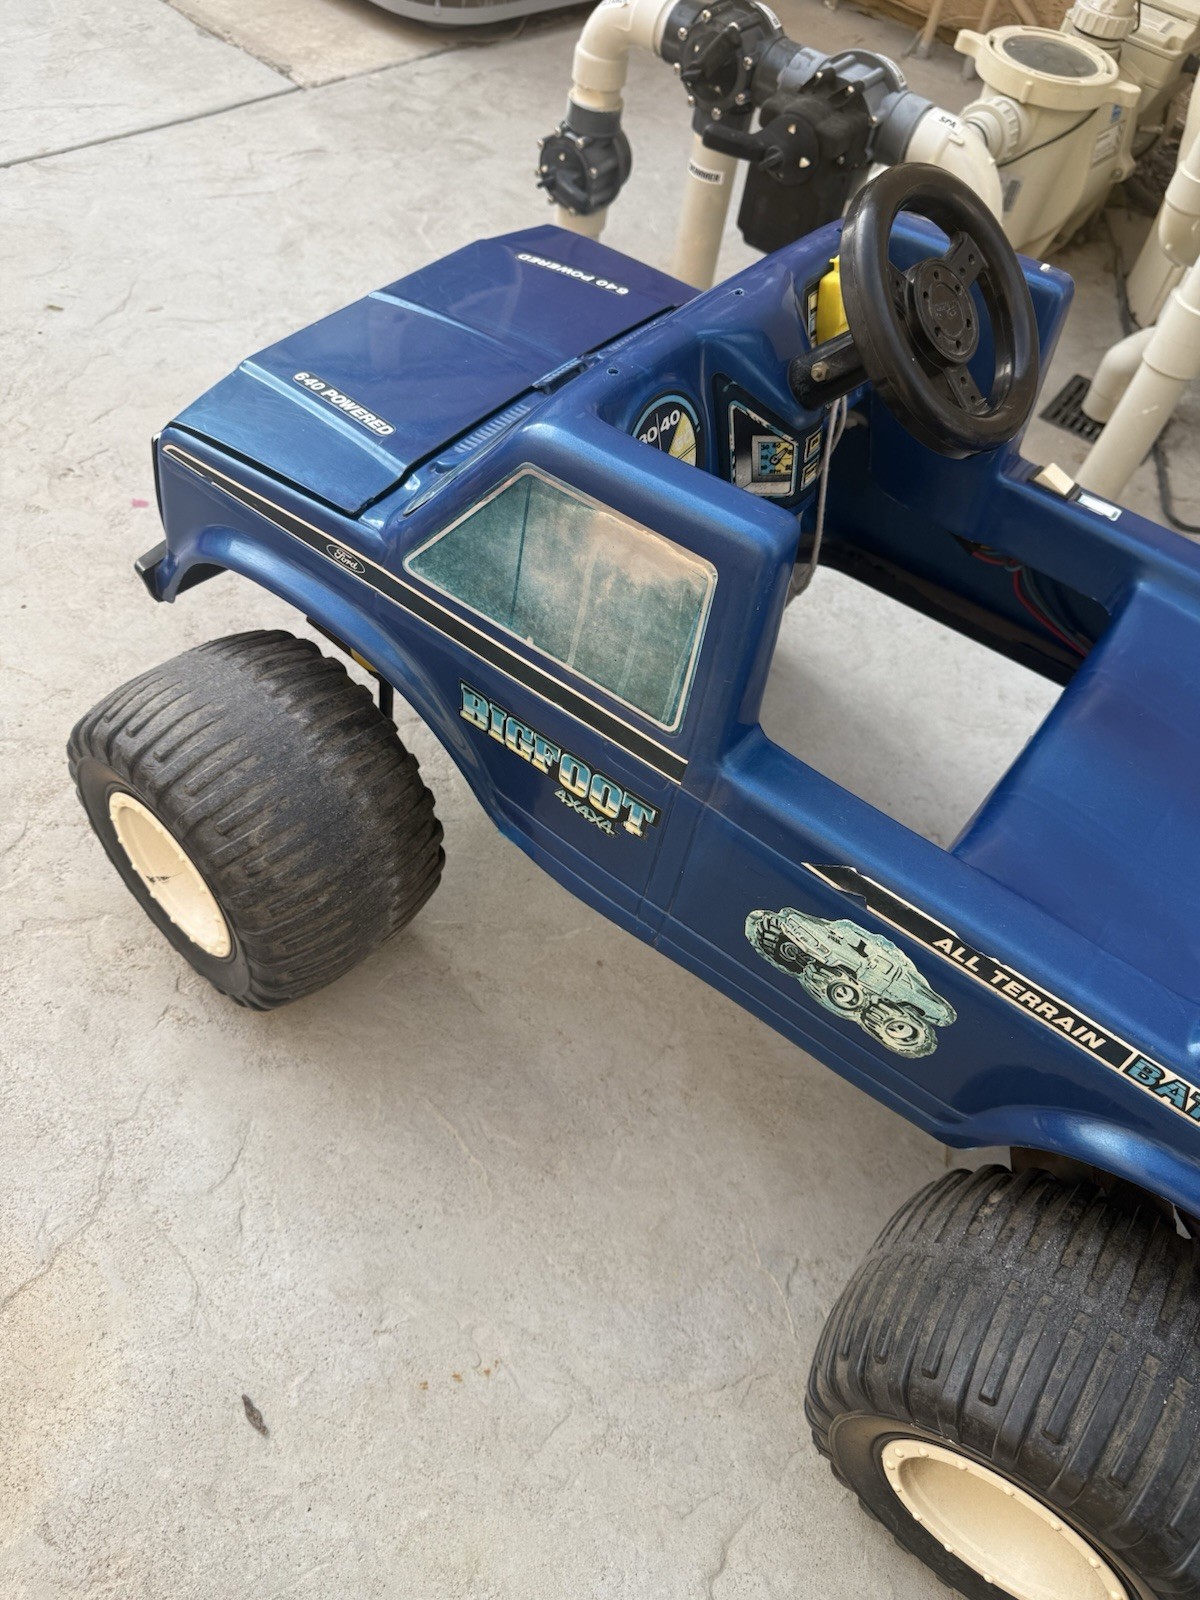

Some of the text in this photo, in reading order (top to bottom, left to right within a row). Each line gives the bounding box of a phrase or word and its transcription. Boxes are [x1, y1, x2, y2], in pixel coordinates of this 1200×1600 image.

[939, 116, 956, 128] SPA
[517, 253, 629, 295] 640 POWERED
[294, 372, 395, 436] 640 POWERED
[660, 409, 681, 432] 40
[334, 548, 358, 569] Ford
[459, 682, 657, 838] BIGFOOT
[932, 938, 981, 972] ALL
[990, 969, 1107, 1050] TERRAIN
